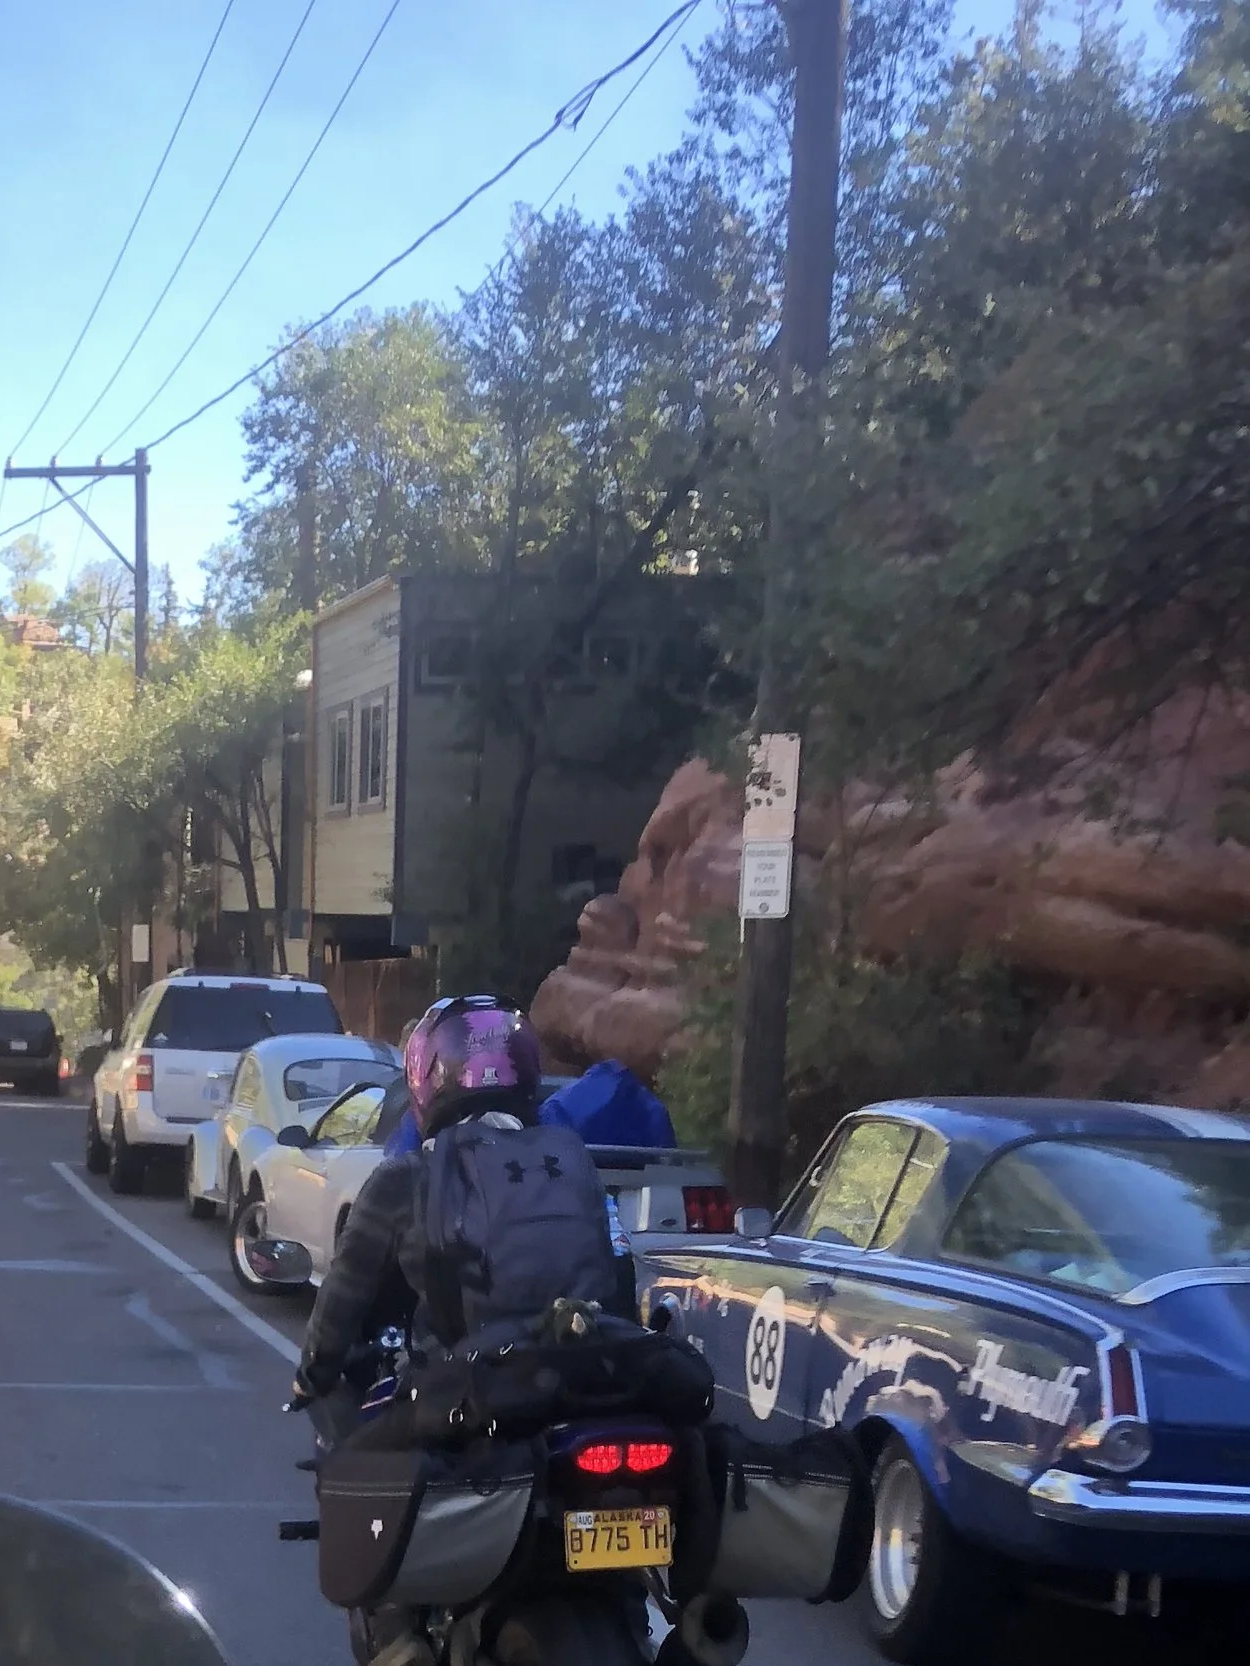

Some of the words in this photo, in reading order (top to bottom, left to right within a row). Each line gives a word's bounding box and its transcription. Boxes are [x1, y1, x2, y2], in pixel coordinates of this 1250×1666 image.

[751, 1316, 779, 1390] 88
[578, 1514, 593, 1526] AUG
[594, 1511, 641, 1523] ALASKA
[644, 1510, 656, 1521] 20
[640, 1524, 668, 1549] TH
